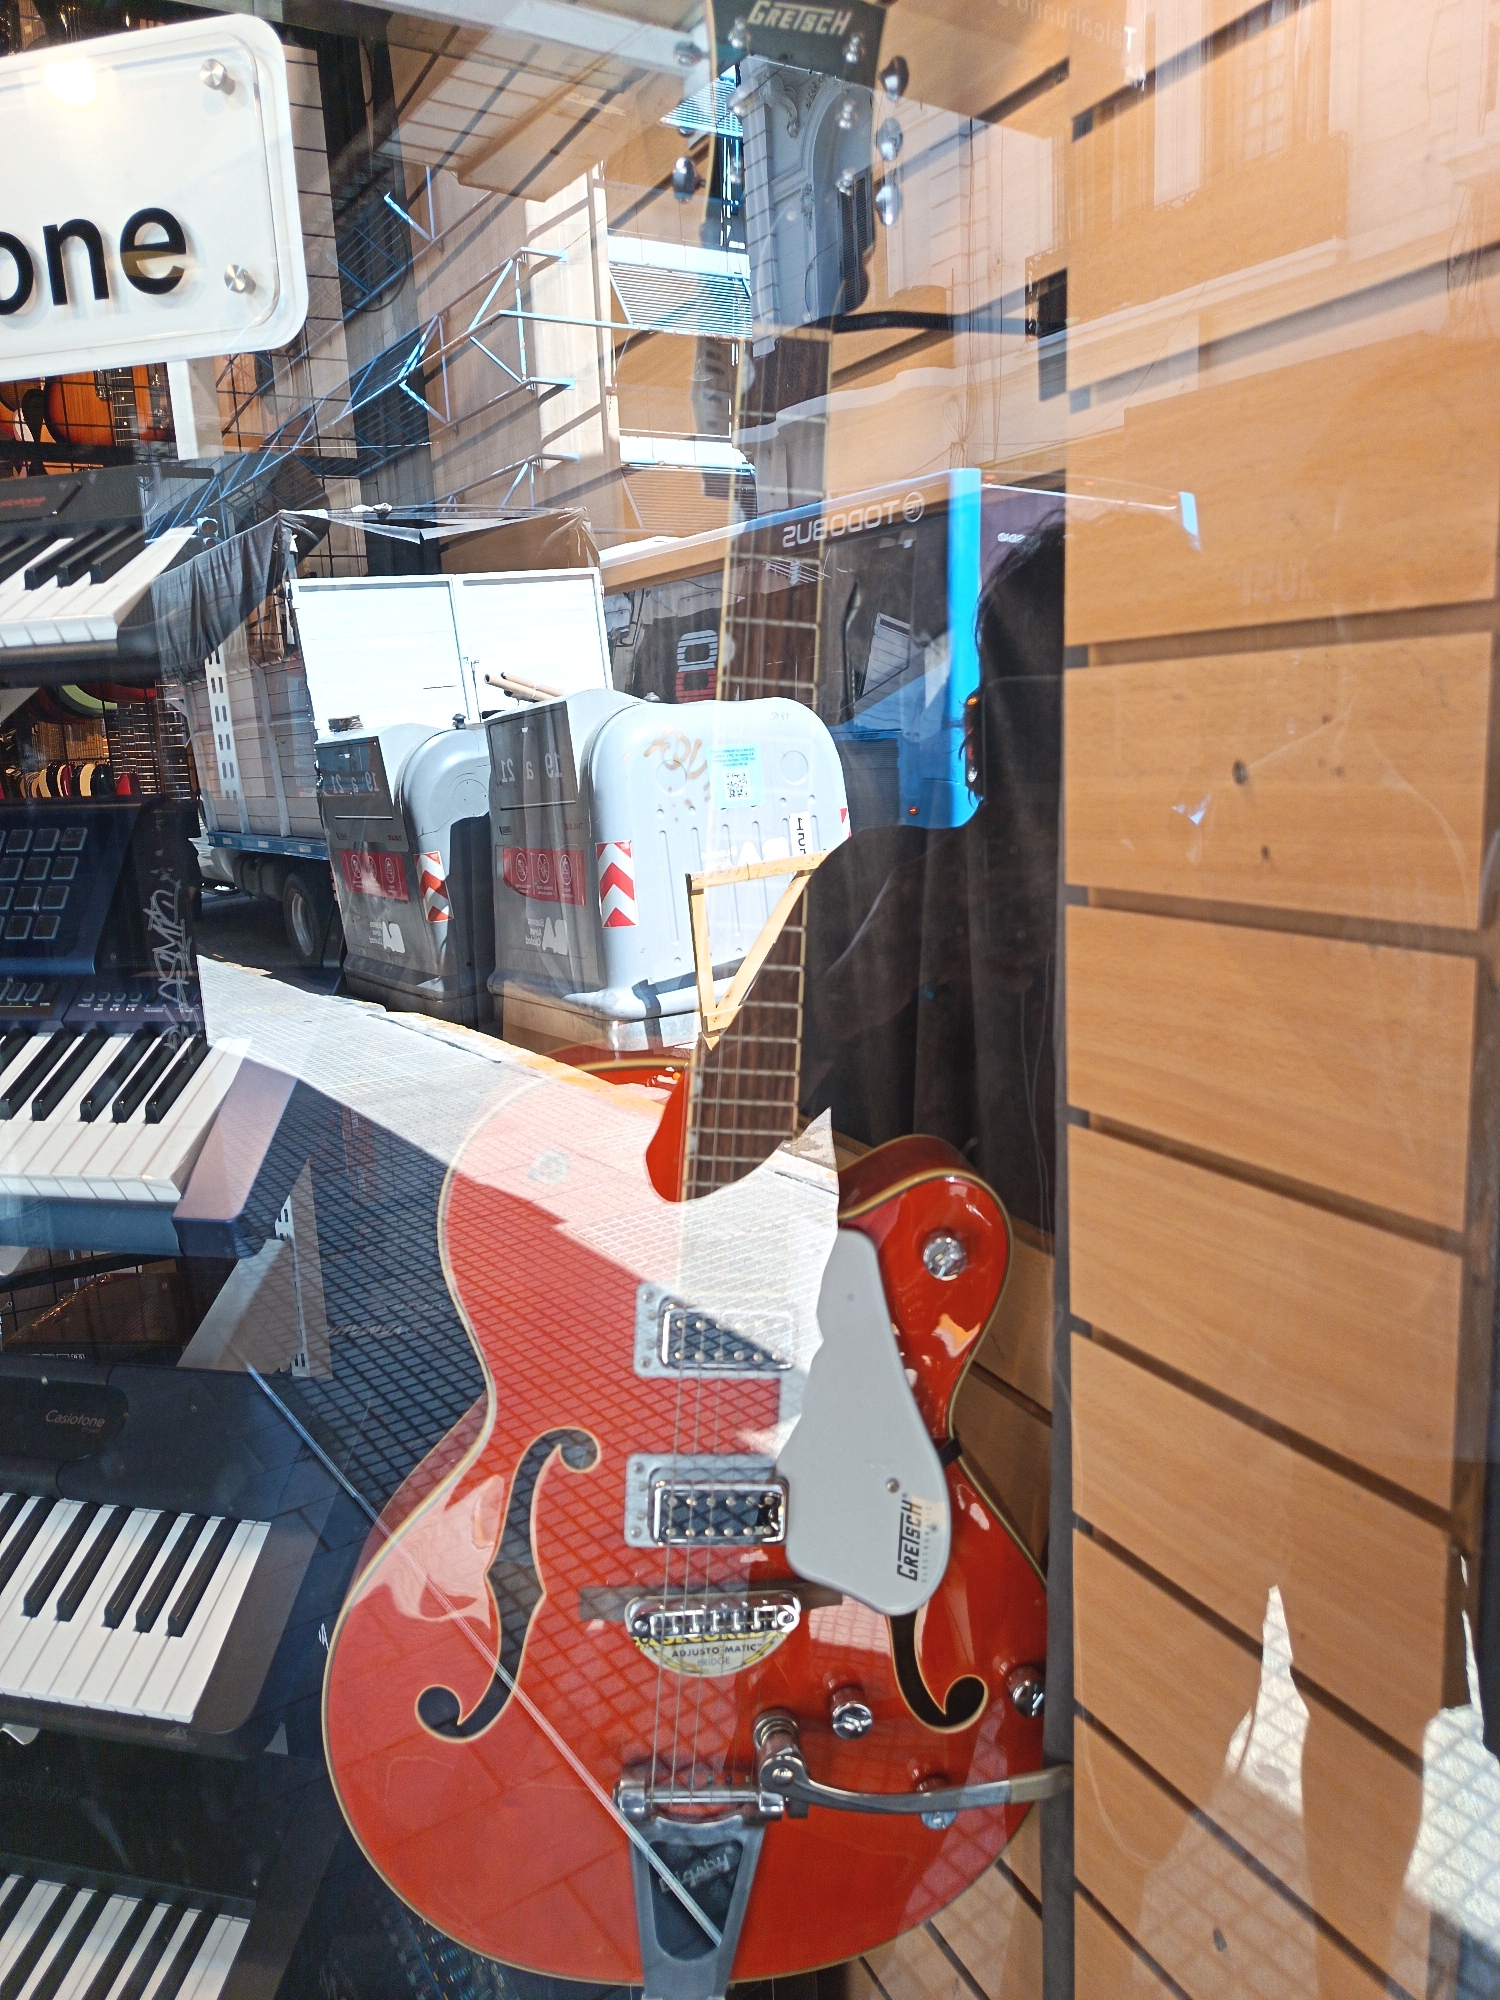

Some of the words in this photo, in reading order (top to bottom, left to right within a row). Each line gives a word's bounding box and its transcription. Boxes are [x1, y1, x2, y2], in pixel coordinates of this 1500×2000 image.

[748, 0, 852, 37] GRETSCH
[45, 1409, 105, 1428] Casiotone
[896, 1499, 923, 1582] GRETSCH
[697, 1656, 731, 1667] BRIDGE
